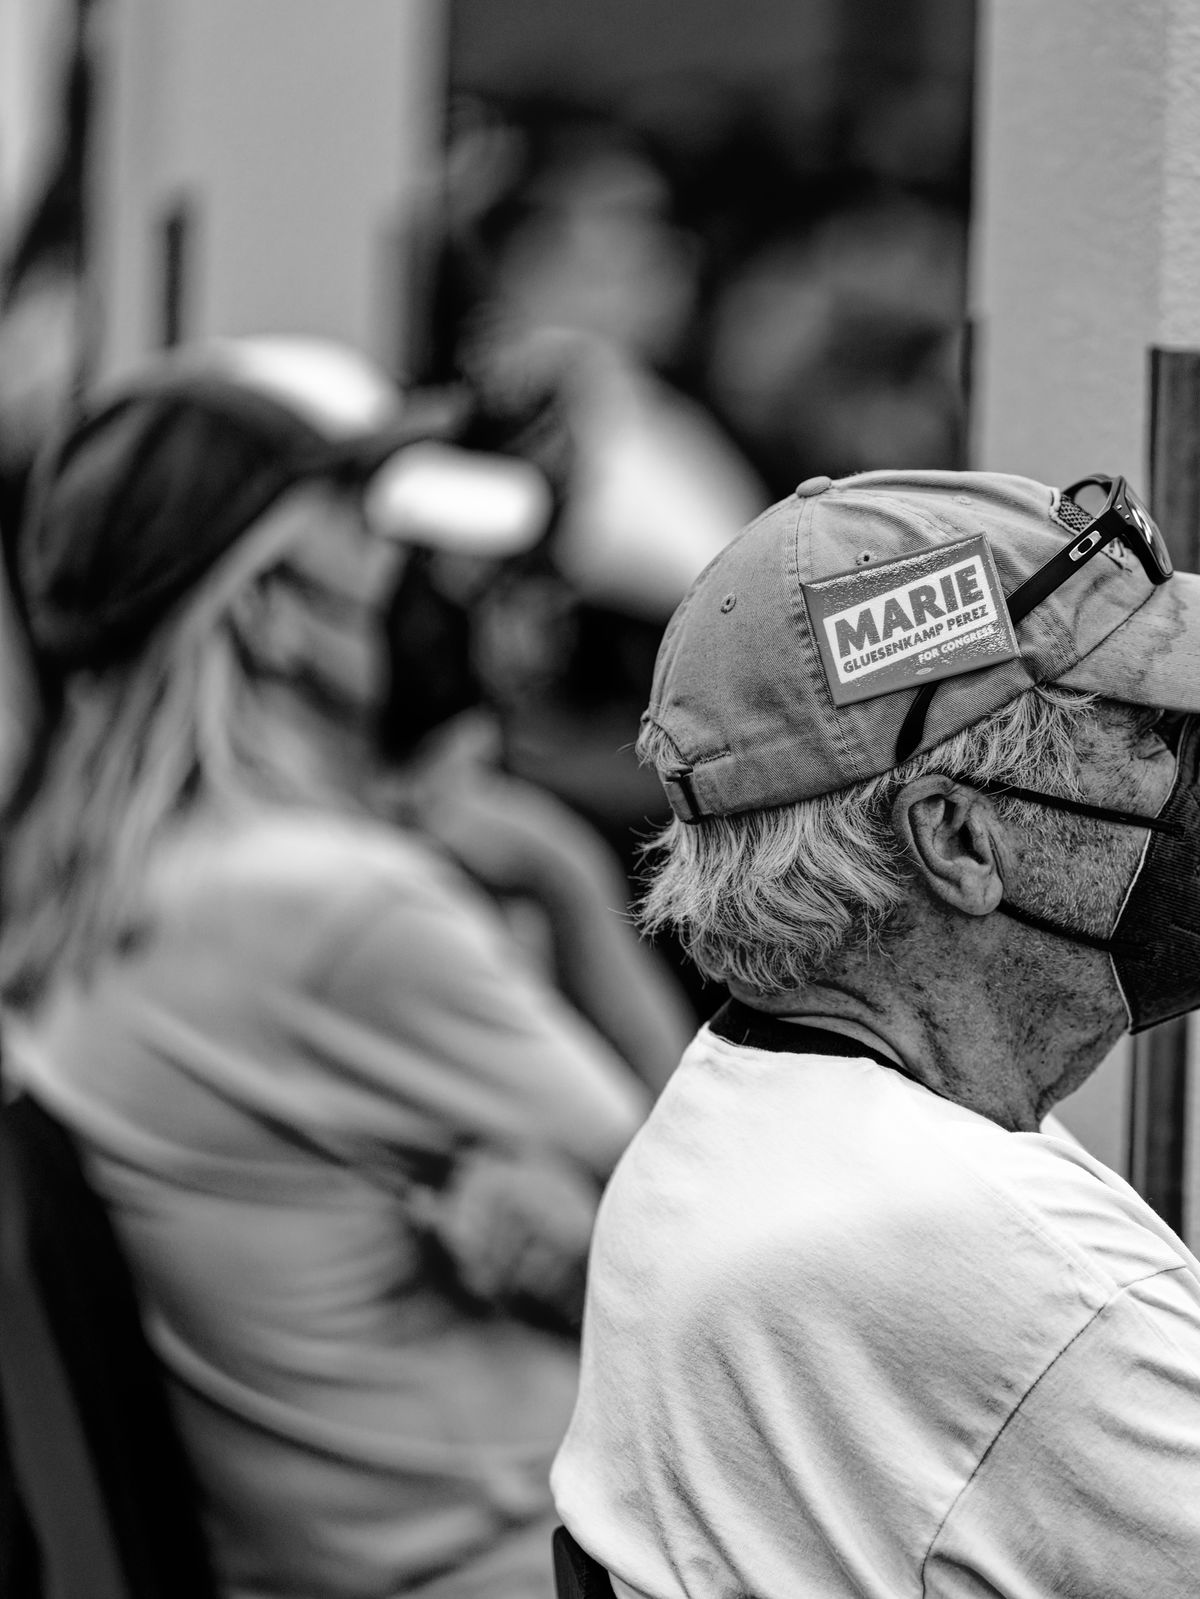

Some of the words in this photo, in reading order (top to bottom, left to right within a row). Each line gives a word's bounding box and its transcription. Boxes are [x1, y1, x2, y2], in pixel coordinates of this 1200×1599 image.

[834, 564, 985, 659] MARIE
[843, 623, 944, 674] GLUESENKAMP
[947, 604, 989, 631] PEREZ
[918, 647, 941, 663] FOR
